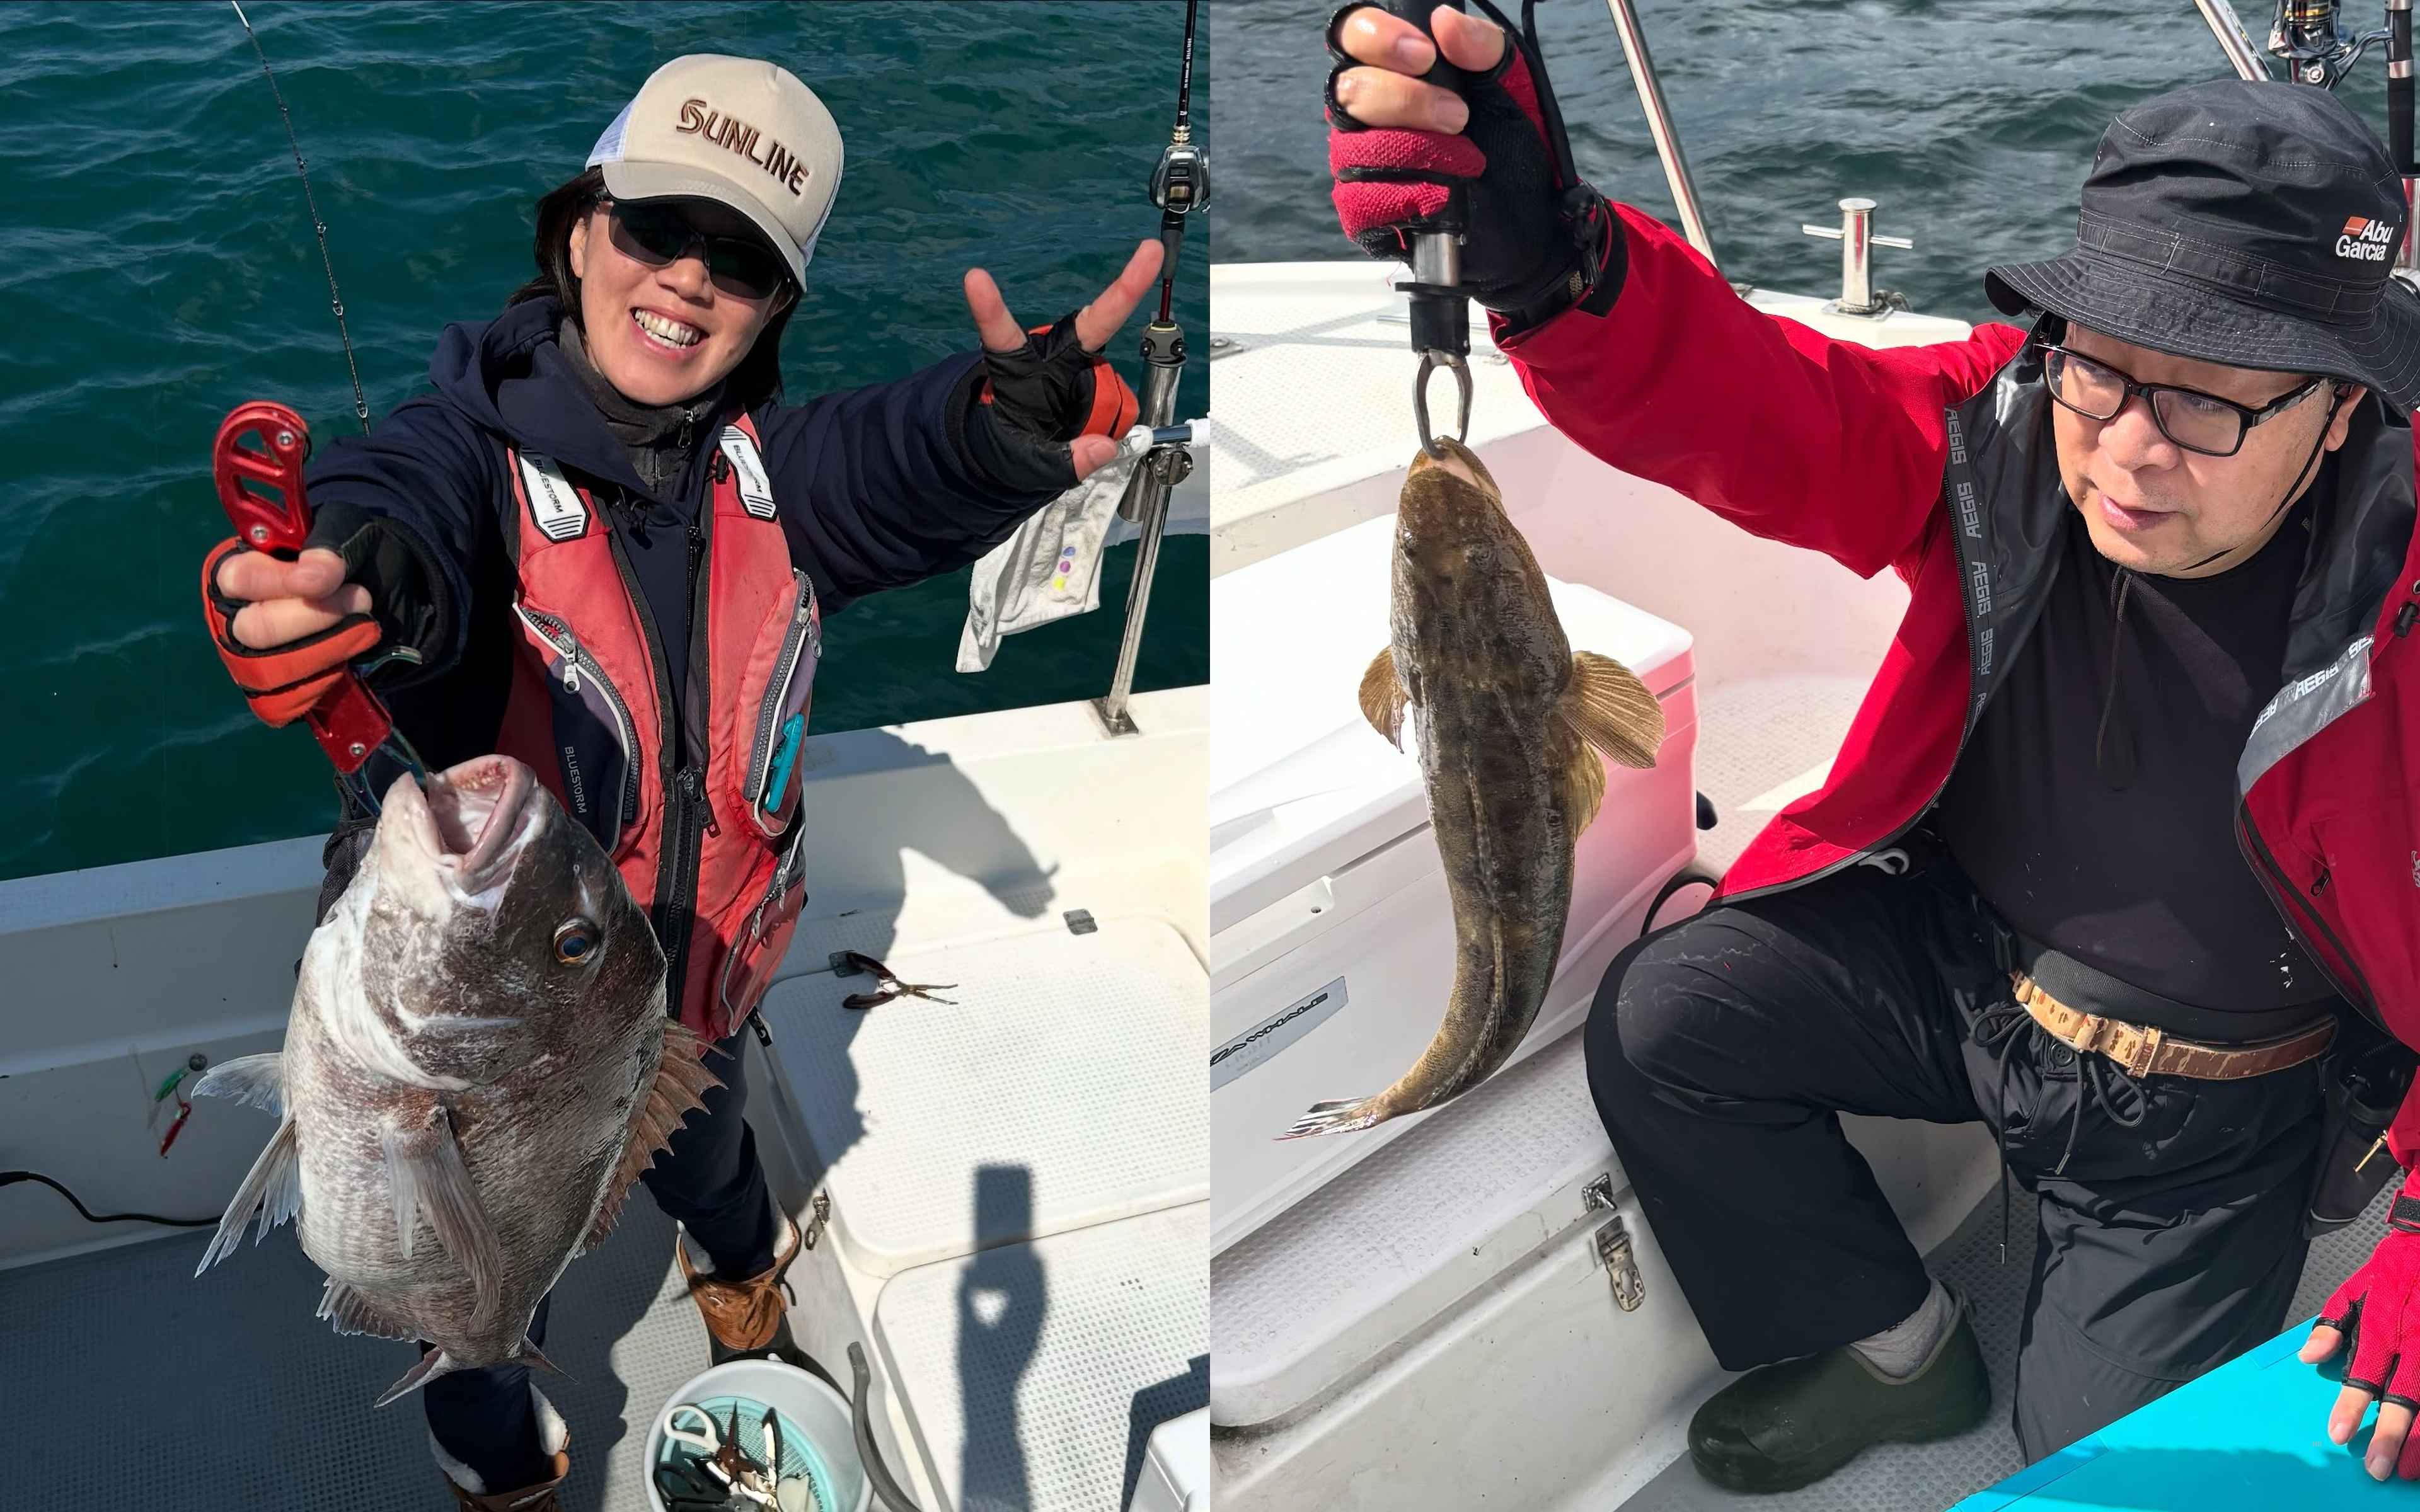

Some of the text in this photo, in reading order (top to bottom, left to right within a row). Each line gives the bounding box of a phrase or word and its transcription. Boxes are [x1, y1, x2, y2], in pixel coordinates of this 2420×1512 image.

[676, 99, 809, 196] SUNLINE
[2336, 234, 2387, 261] Garcia
[2360, 220, 2394, 243] Abu
[1944, 408, 1967, 464] AEGIS
[534, 459, 563, 513] BLUESTORM
[1957, 481, 1982, 539] AEGIS
[1972, 561, 1991, 616] AEGIS
[1981, 628, 1993, 676] AEGIS
[2294, 662, 2340, 701] AEGIS
[565, 746, 587, 813] BLUESTORM
